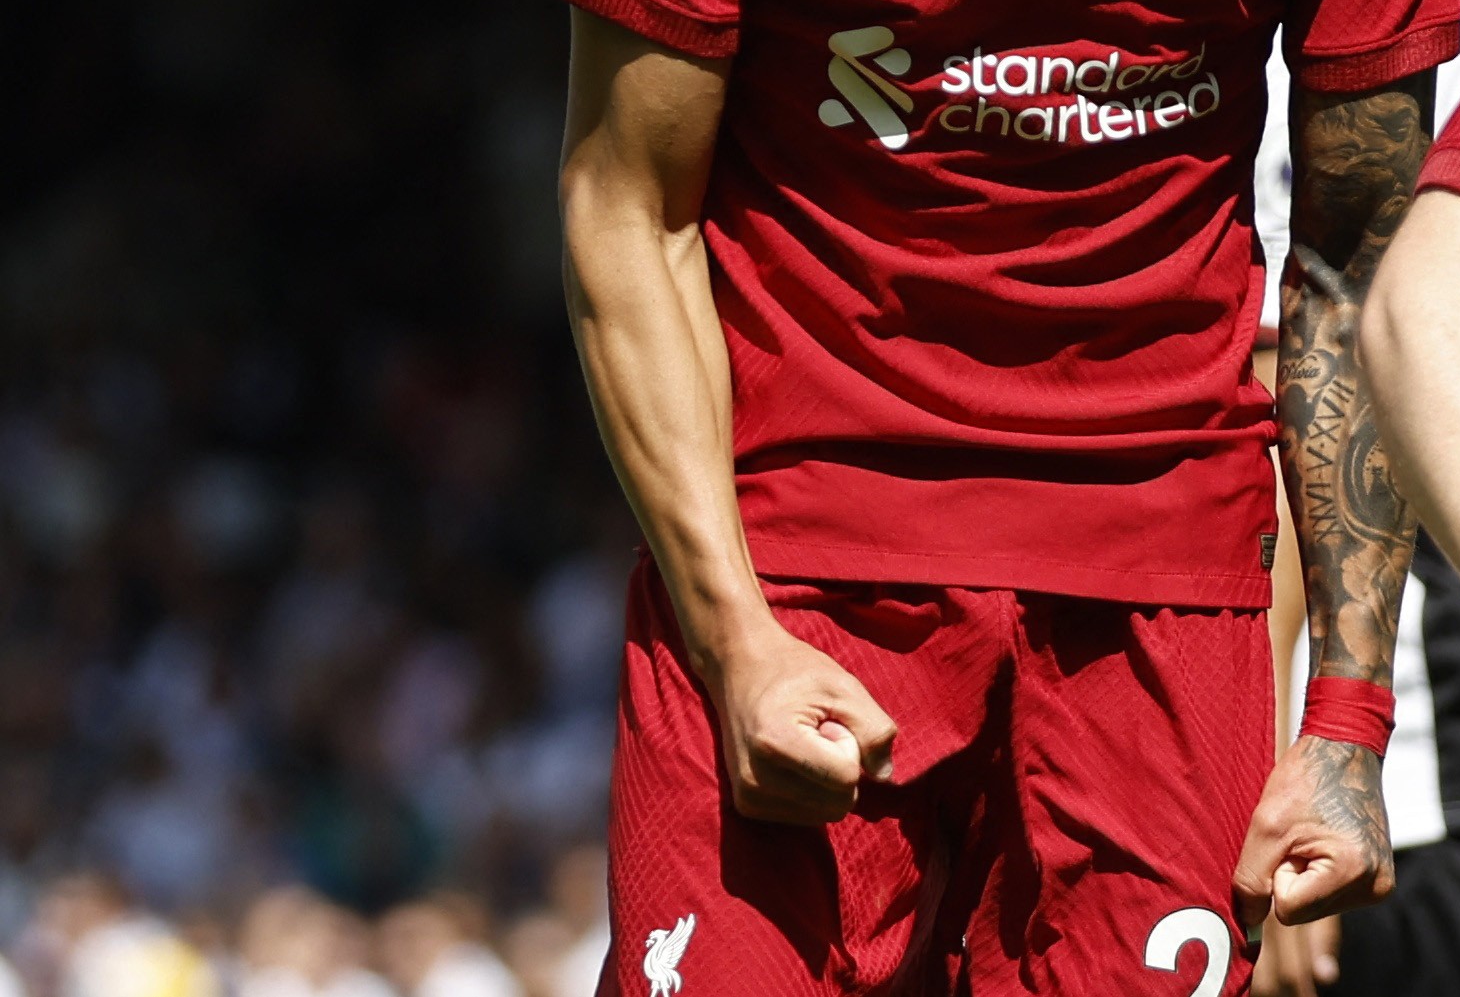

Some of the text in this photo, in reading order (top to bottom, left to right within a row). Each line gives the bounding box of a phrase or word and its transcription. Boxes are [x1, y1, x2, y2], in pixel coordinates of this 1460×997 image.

[940, 40, 1206, 97] standard
[939, 71, 1221, 144] chartered
[1144, 906, 1232, 997] 2
